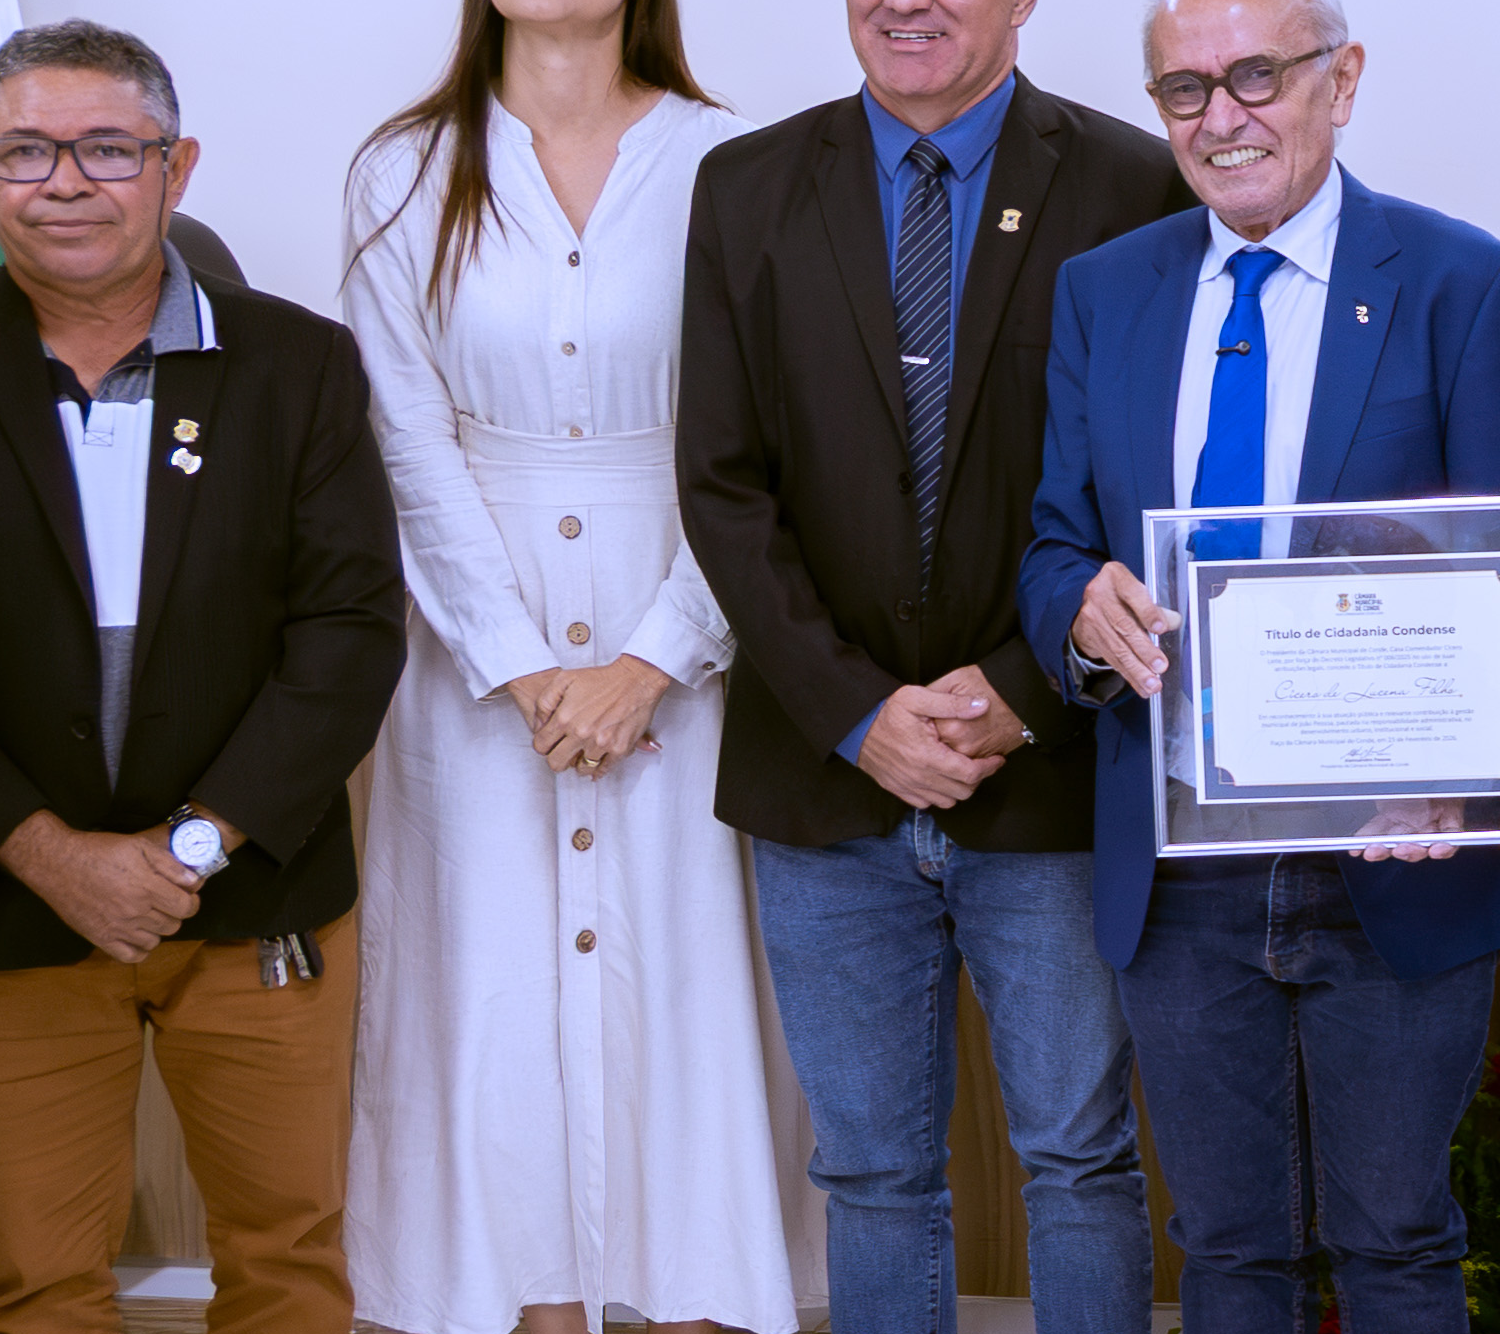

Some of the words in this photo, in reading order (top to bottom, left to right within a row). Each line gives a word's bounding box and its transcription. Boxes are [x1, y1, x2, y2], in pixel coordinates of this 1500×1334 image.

[1265, 627, 1301, 640] Título
[1304, 627, 1321, 639] de
[1324, 625, 1389, 639] Cidadania
[1392, 624, 1457, 637] Condense
